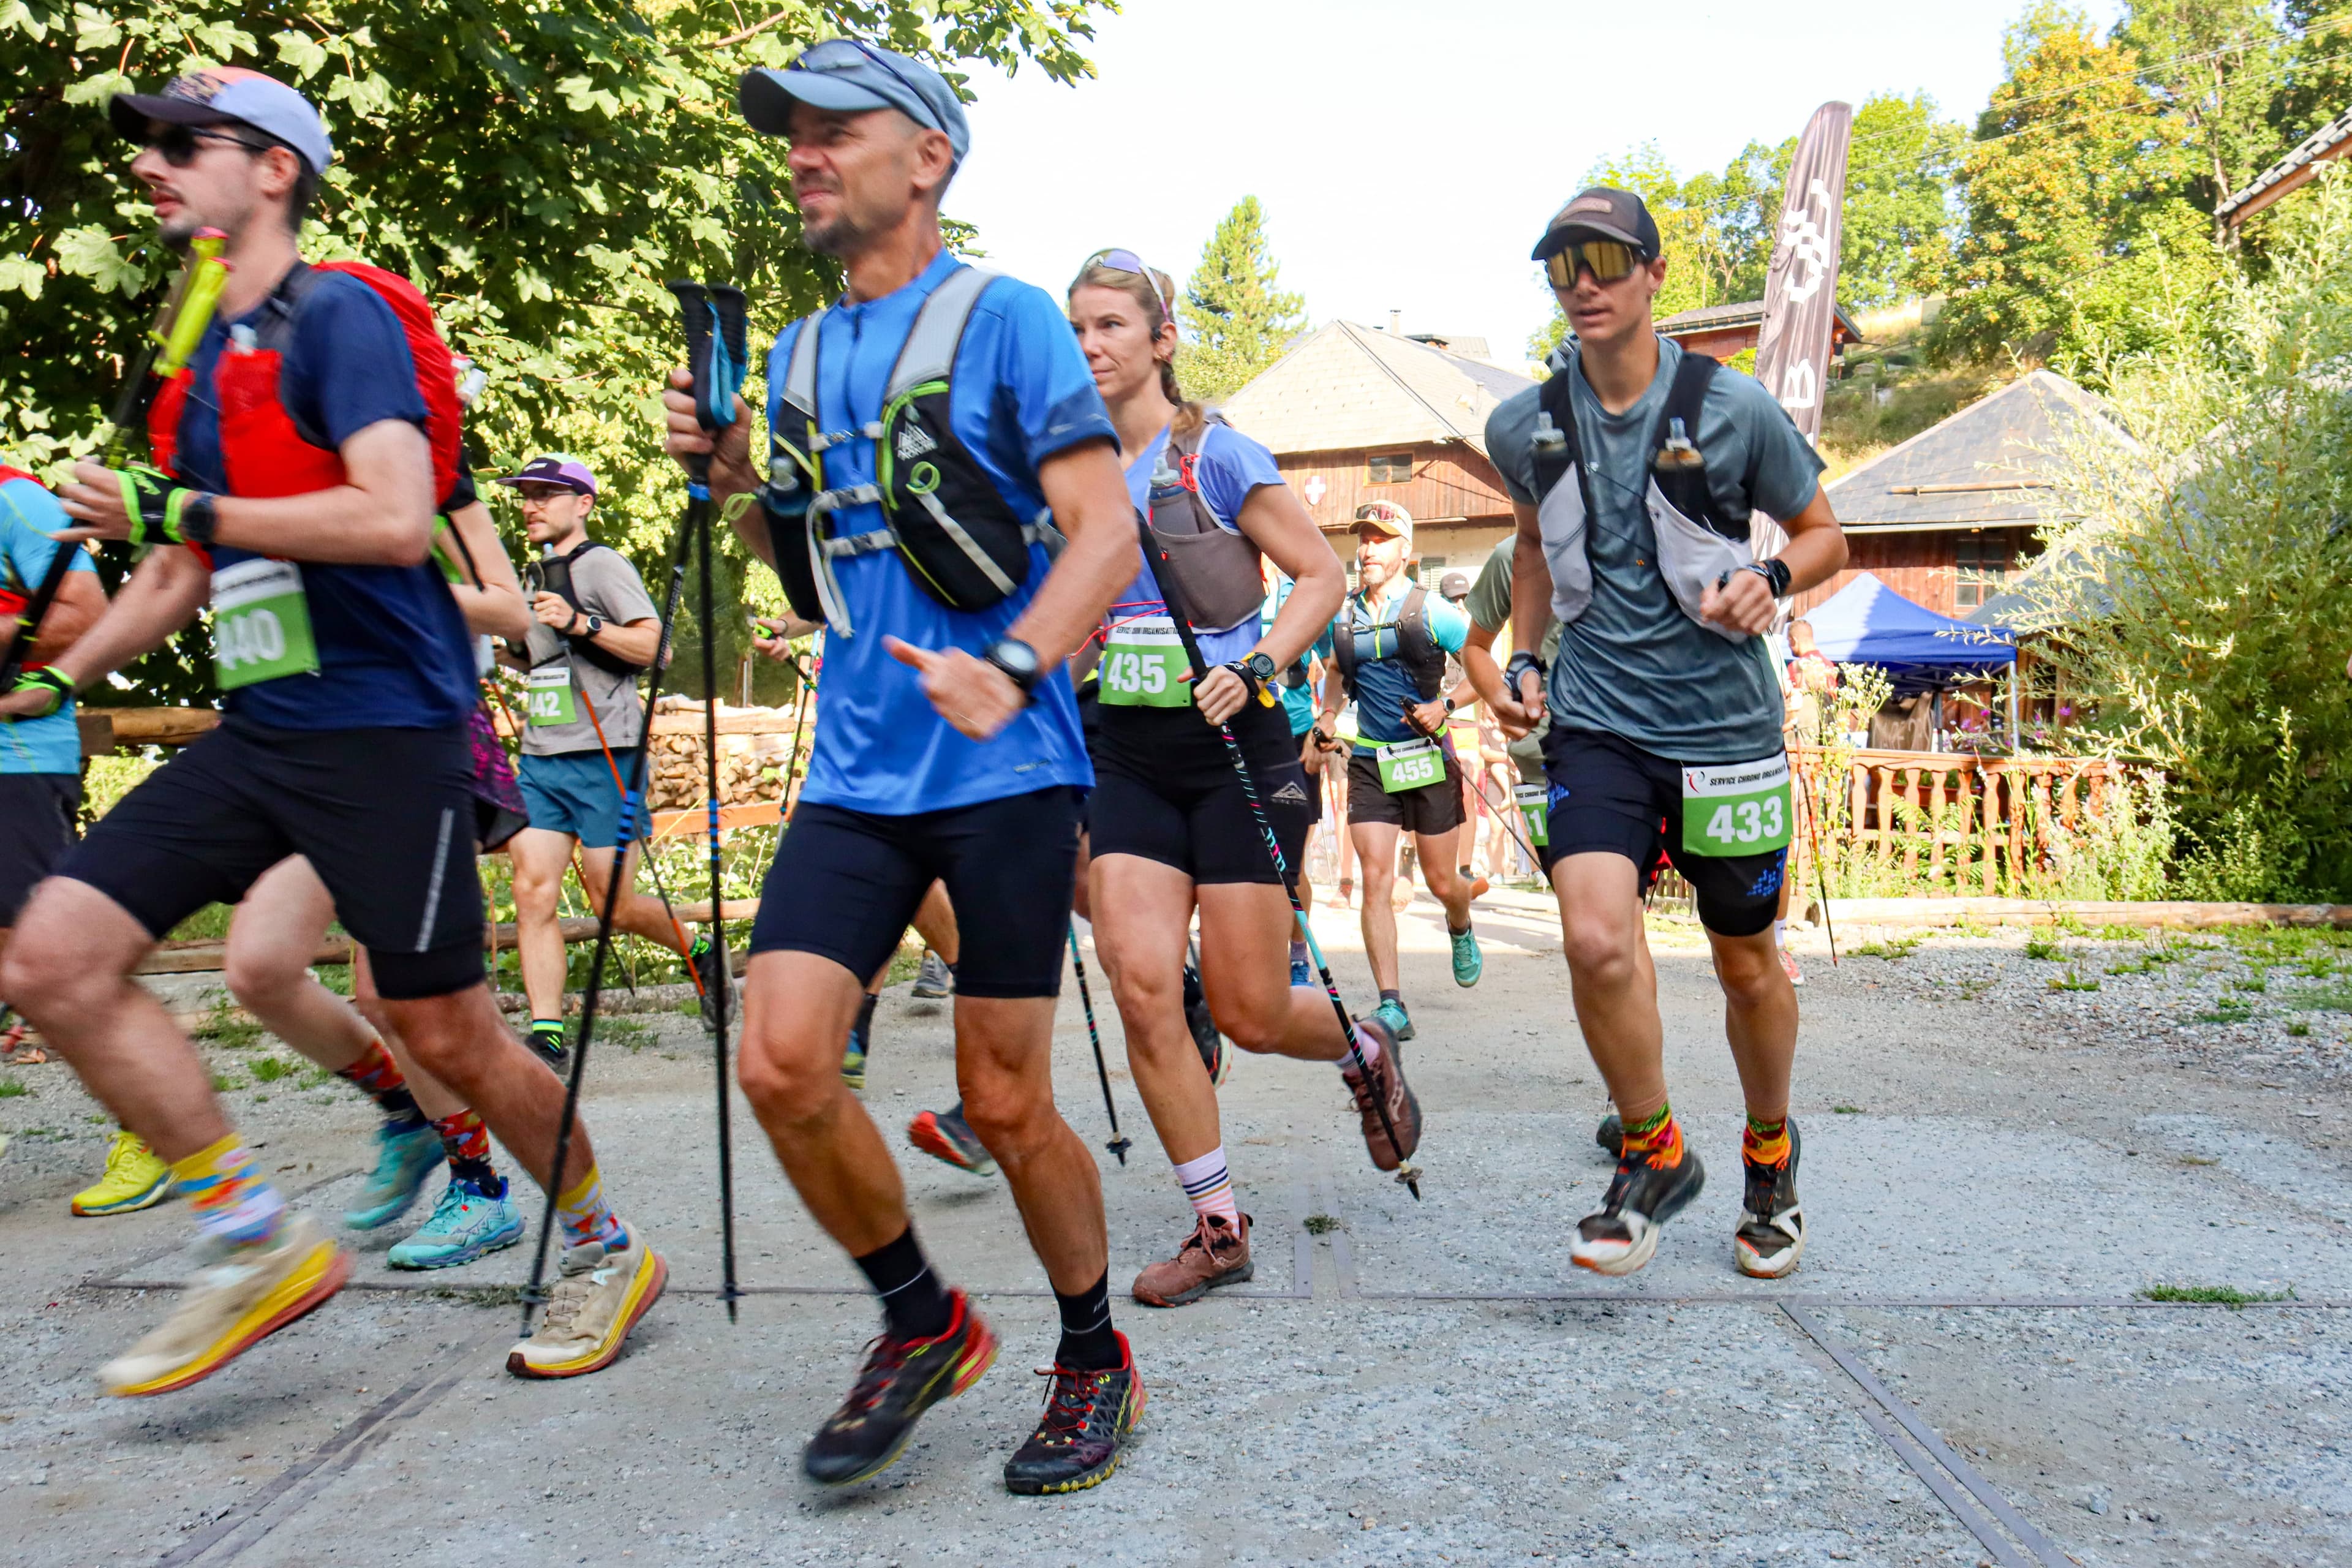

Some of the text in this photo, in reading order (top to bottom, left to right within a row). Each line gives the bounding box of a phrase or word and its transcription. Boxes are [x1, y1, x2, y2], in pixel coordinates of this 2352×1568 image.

[1107, 652, 1167, 694] 435
[1392, 756, 1434, 783] 455
[1709, 777, 1736, 787] SERVICE
[1738, 772, 1762, 785] CHRONO
[1706, 795, 1784, 844] 433
